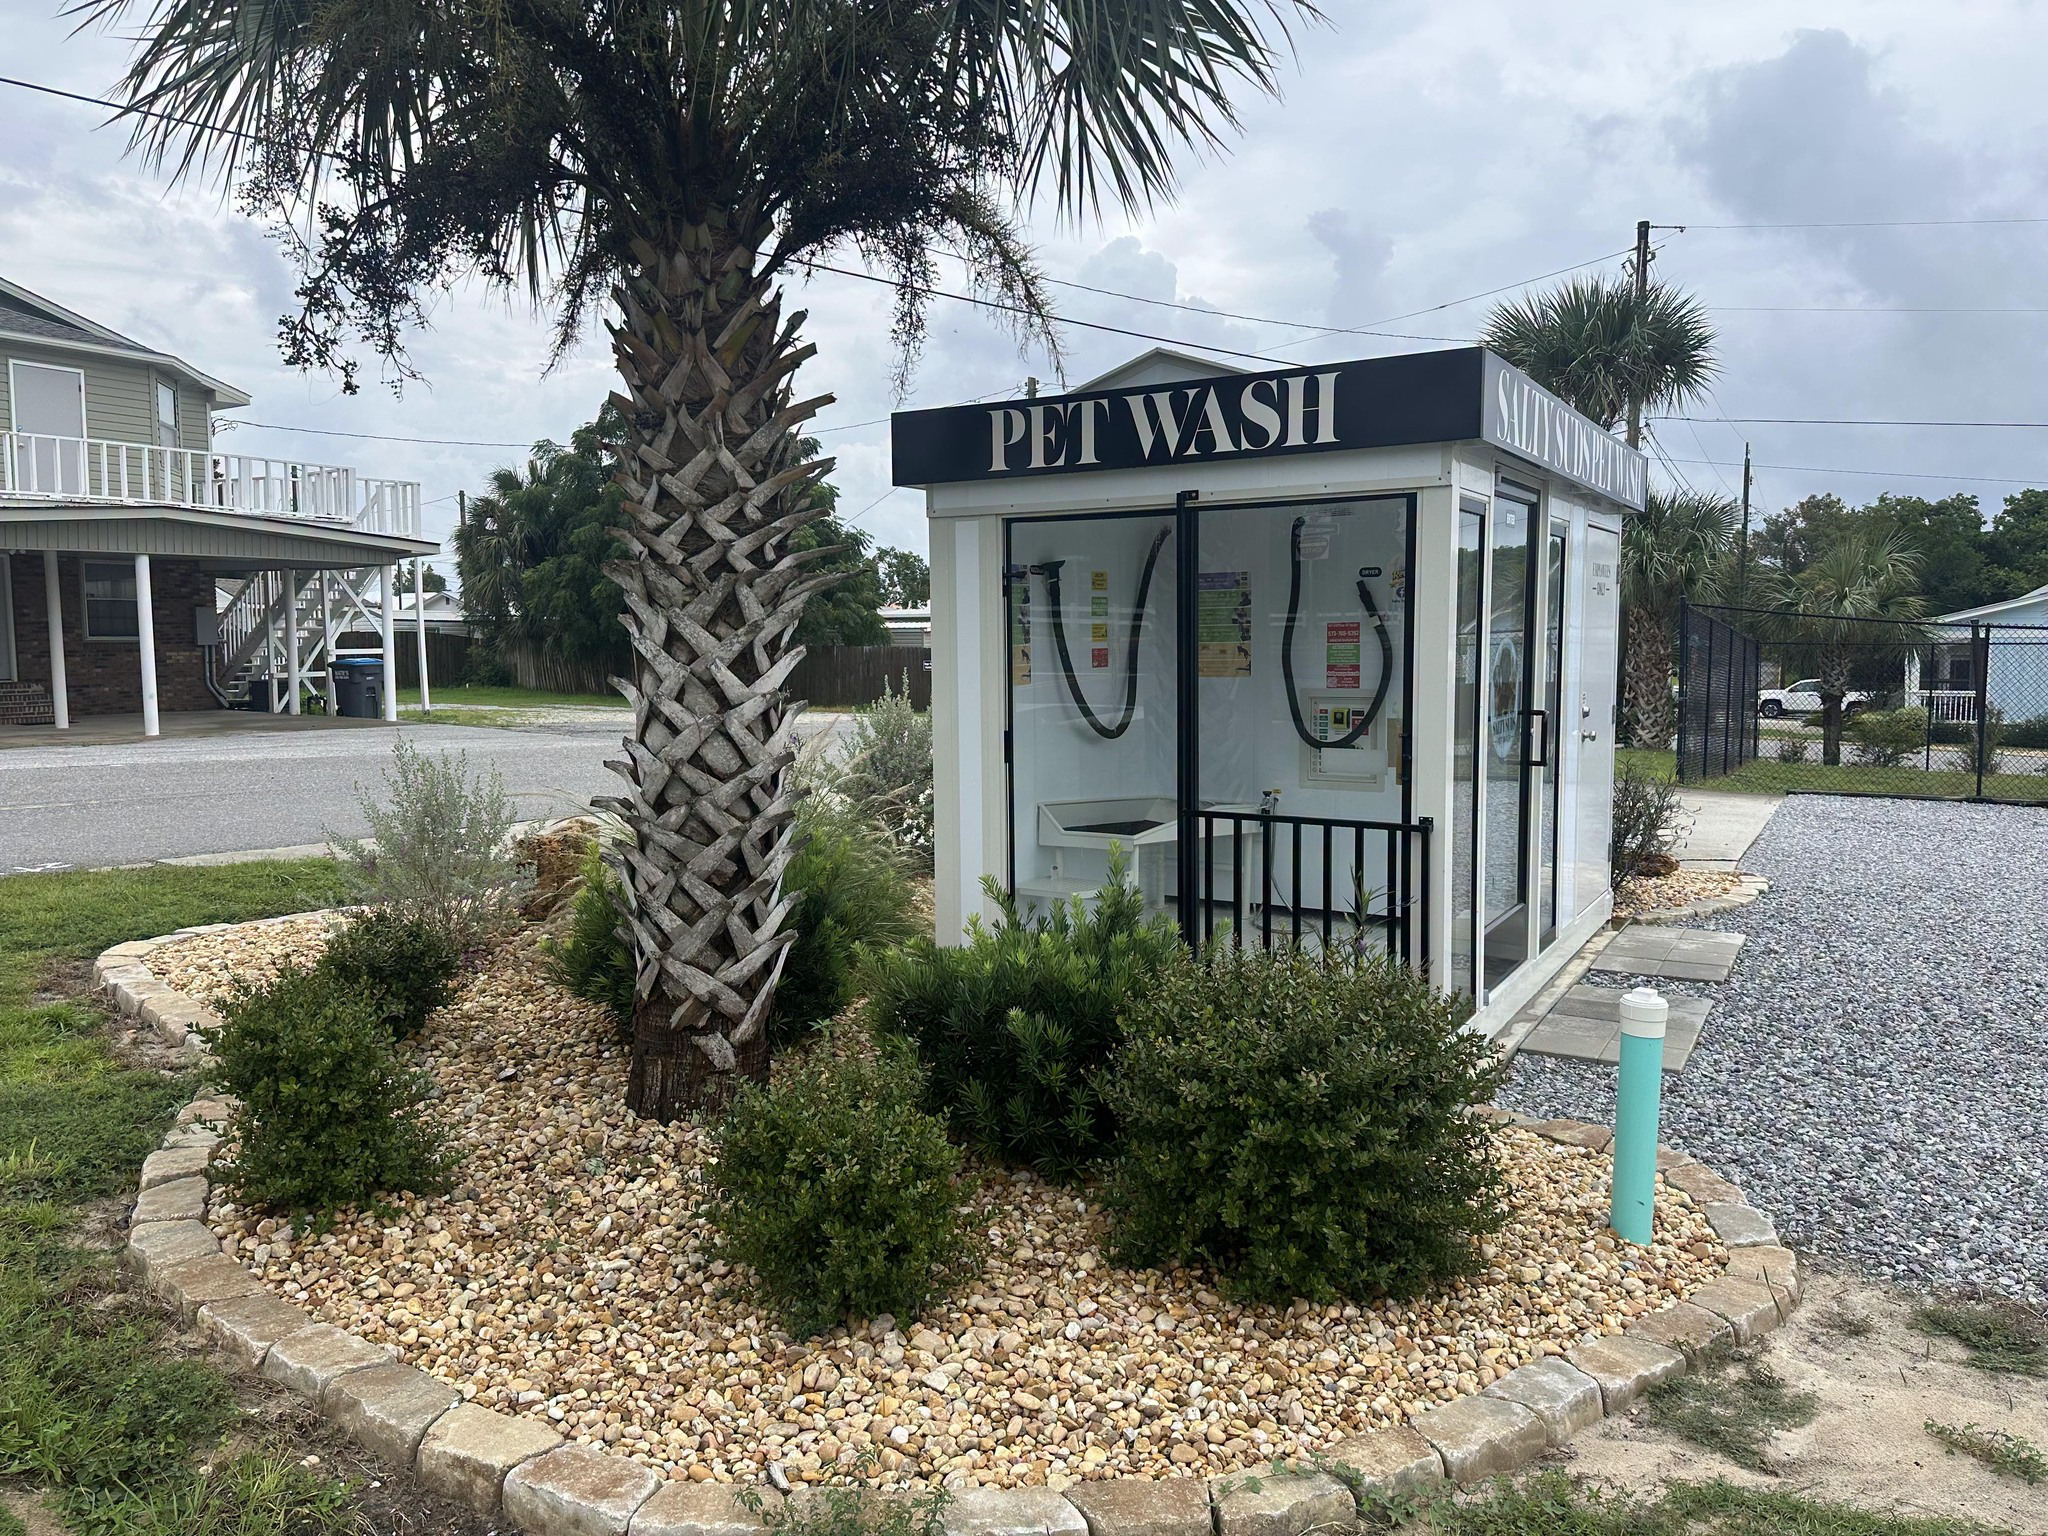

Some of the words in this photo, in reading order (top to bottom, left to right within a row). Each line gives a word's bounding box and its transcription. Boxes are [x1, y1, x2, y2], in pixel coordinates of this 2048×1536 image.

[987, 398, 1111, 472] PET
[1122, 371, 1342, 460] WASH
[1497, 369, 1554, 461] SALTY
[1555, 407, 1591, 481] SUDS
[1591, 429, 1615, 492] PET
[1612, 444, 1643, 505] WASH
[1592, 562, 1611, 578] EMPLOYEES
